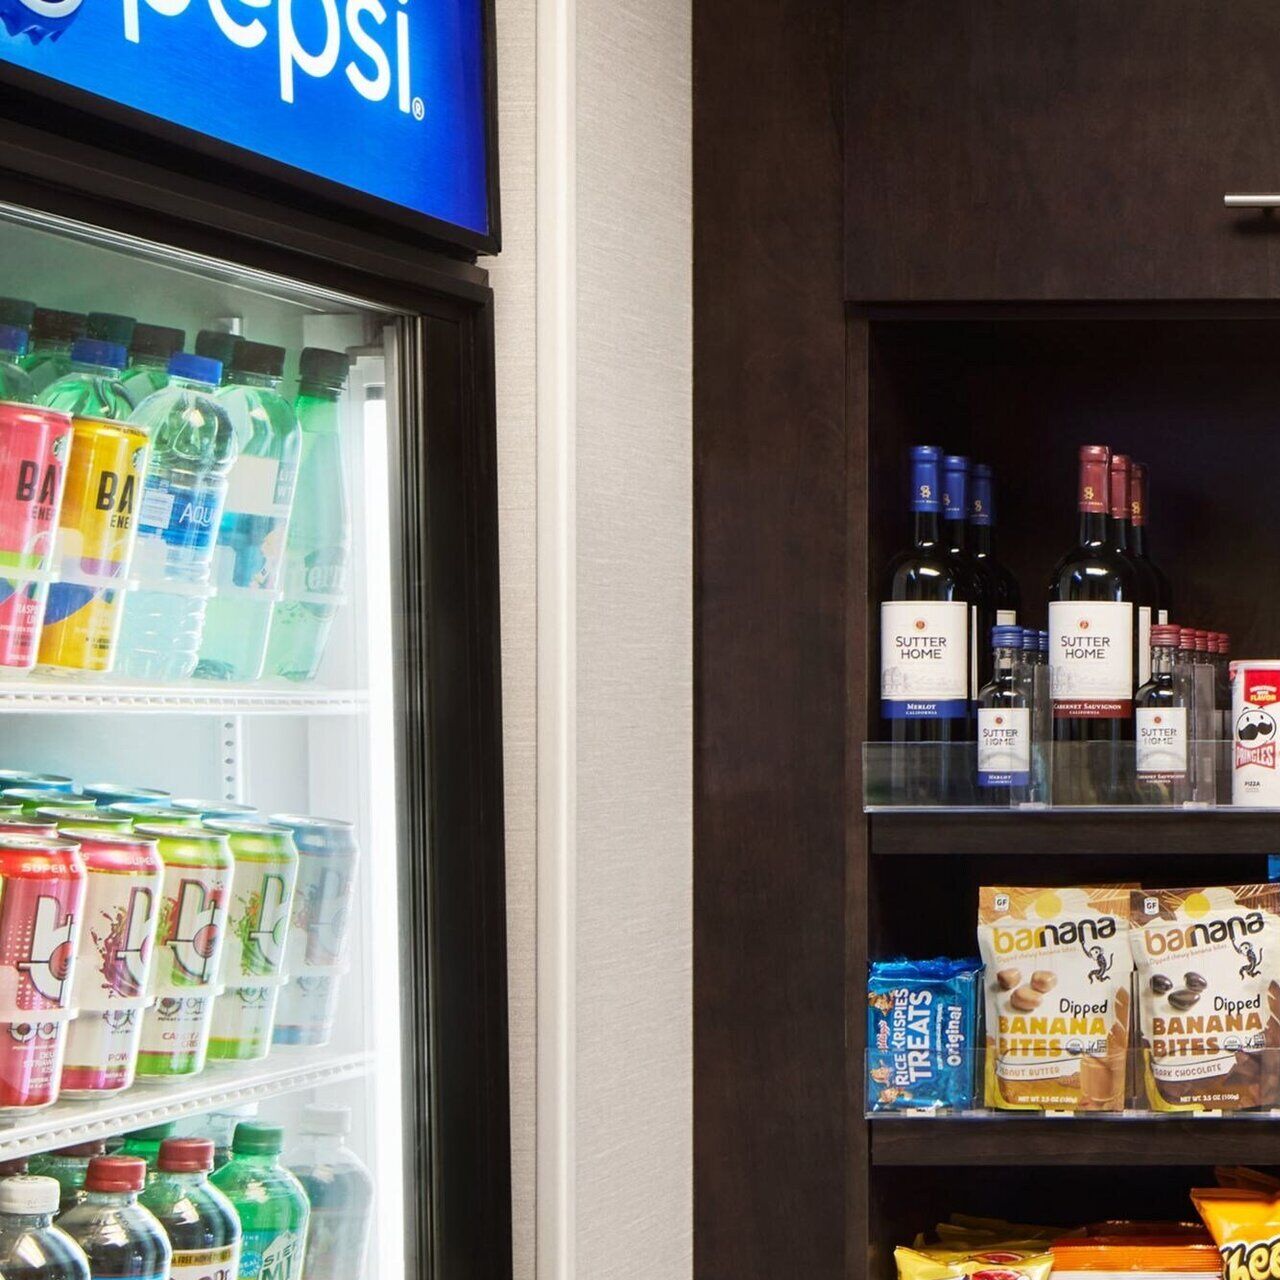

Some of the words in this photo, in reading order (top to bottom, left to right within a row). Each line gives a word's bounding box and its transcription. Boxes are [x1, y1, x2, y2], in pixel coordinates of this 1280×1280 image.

[16, 460, 55, 502] BA
[895, 636, 946, 648] SUTTER
[1061, 636, 1110, 648] SUTTER
[901, 648, 942, 659] HOME
[1065, 648, 1105, 659] HOME
[1059, 997, 1108, 1015] Dipped
[1213, 995, 1261, 1015] Dipped
[999, 1016, 1106, 1036] BANANA
[1153, 1012, 1263, 1035] BANANA
[909, 990, 932, 1082] TREATS
[948, 1006, 962, 1067] Original
[999, 1037, 1064, 1057] BITES
